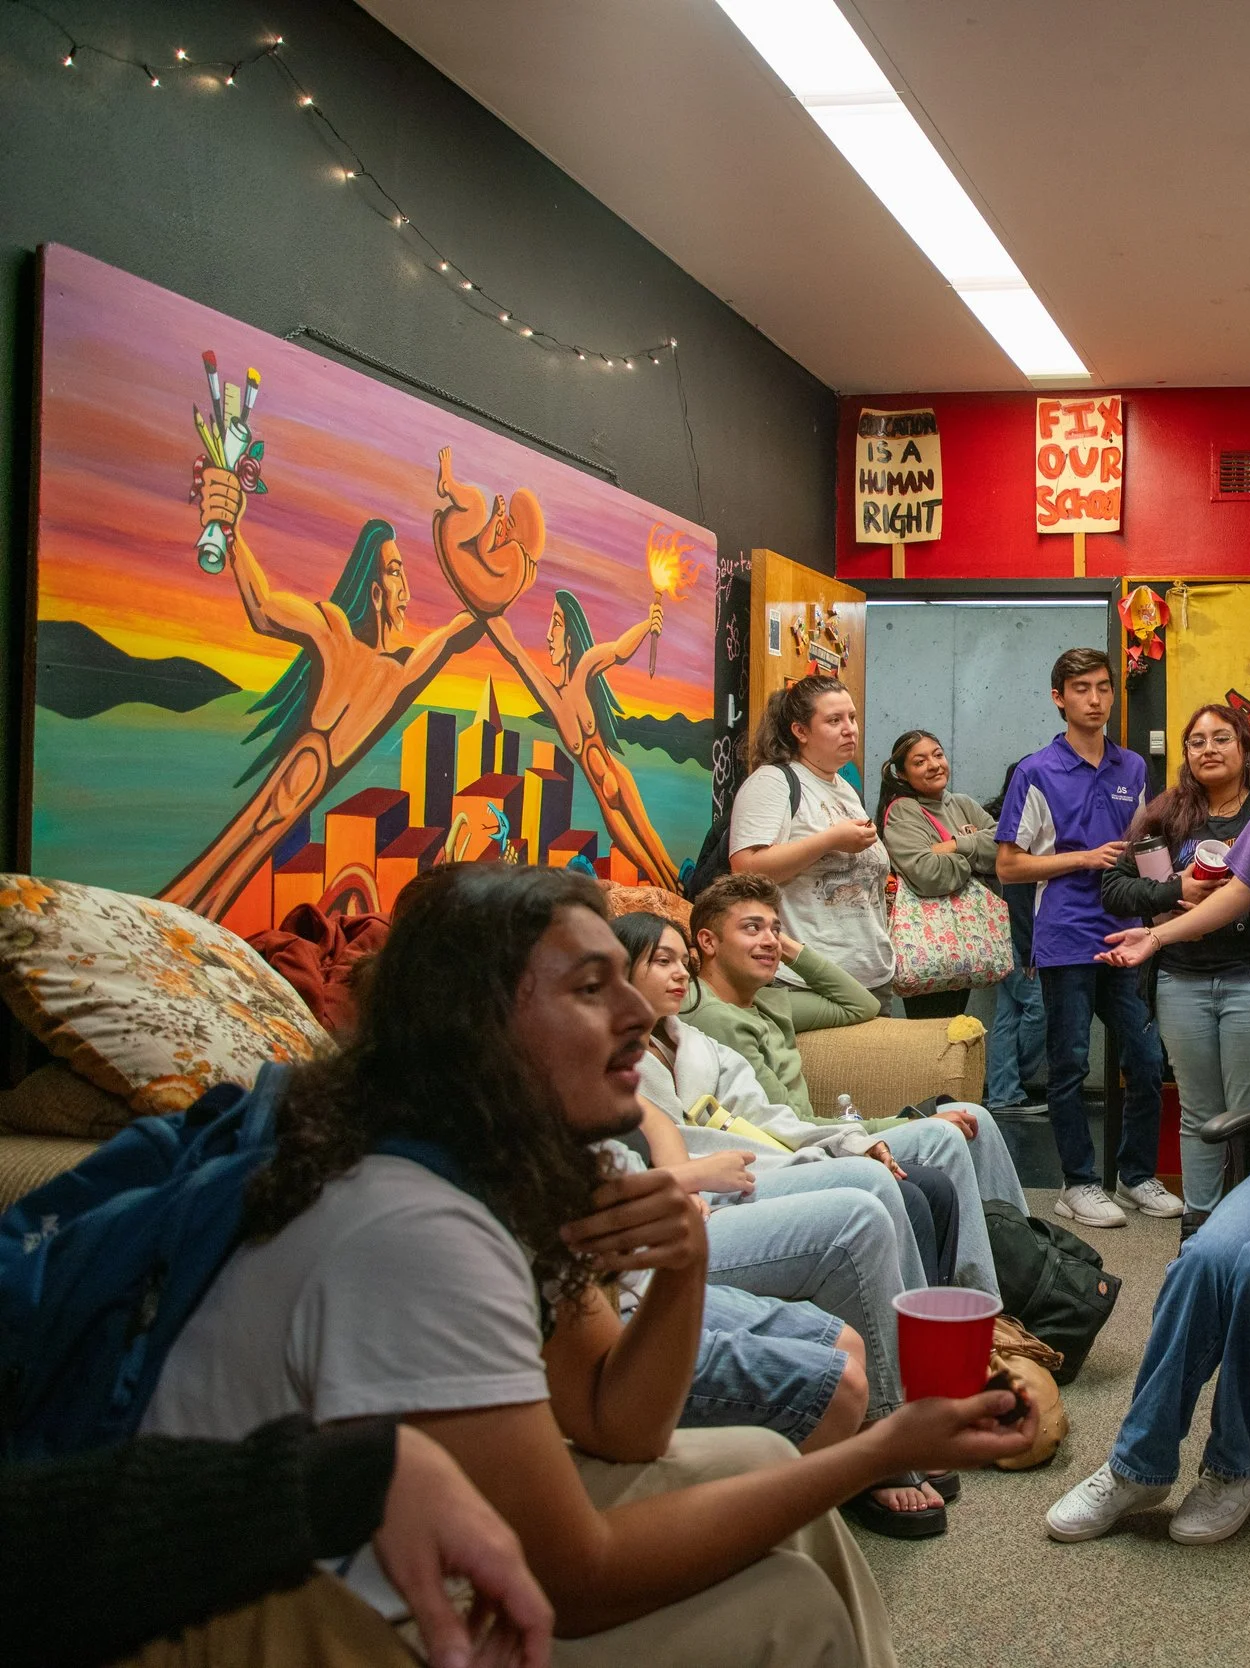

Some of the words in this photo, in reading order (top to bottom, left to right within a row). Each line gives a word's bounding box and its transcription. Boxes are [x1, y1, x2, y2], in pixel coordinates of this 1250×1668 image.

[1039, 398, 1122, 440] FIX
[868, 440, 892, 463] IS
[901, 440, 922, 464] A
[1038, 444, 1121, 483] OUR
[860, 468, 934, 496] HUMAN
[863, 499, 942, 539] RIGHT
